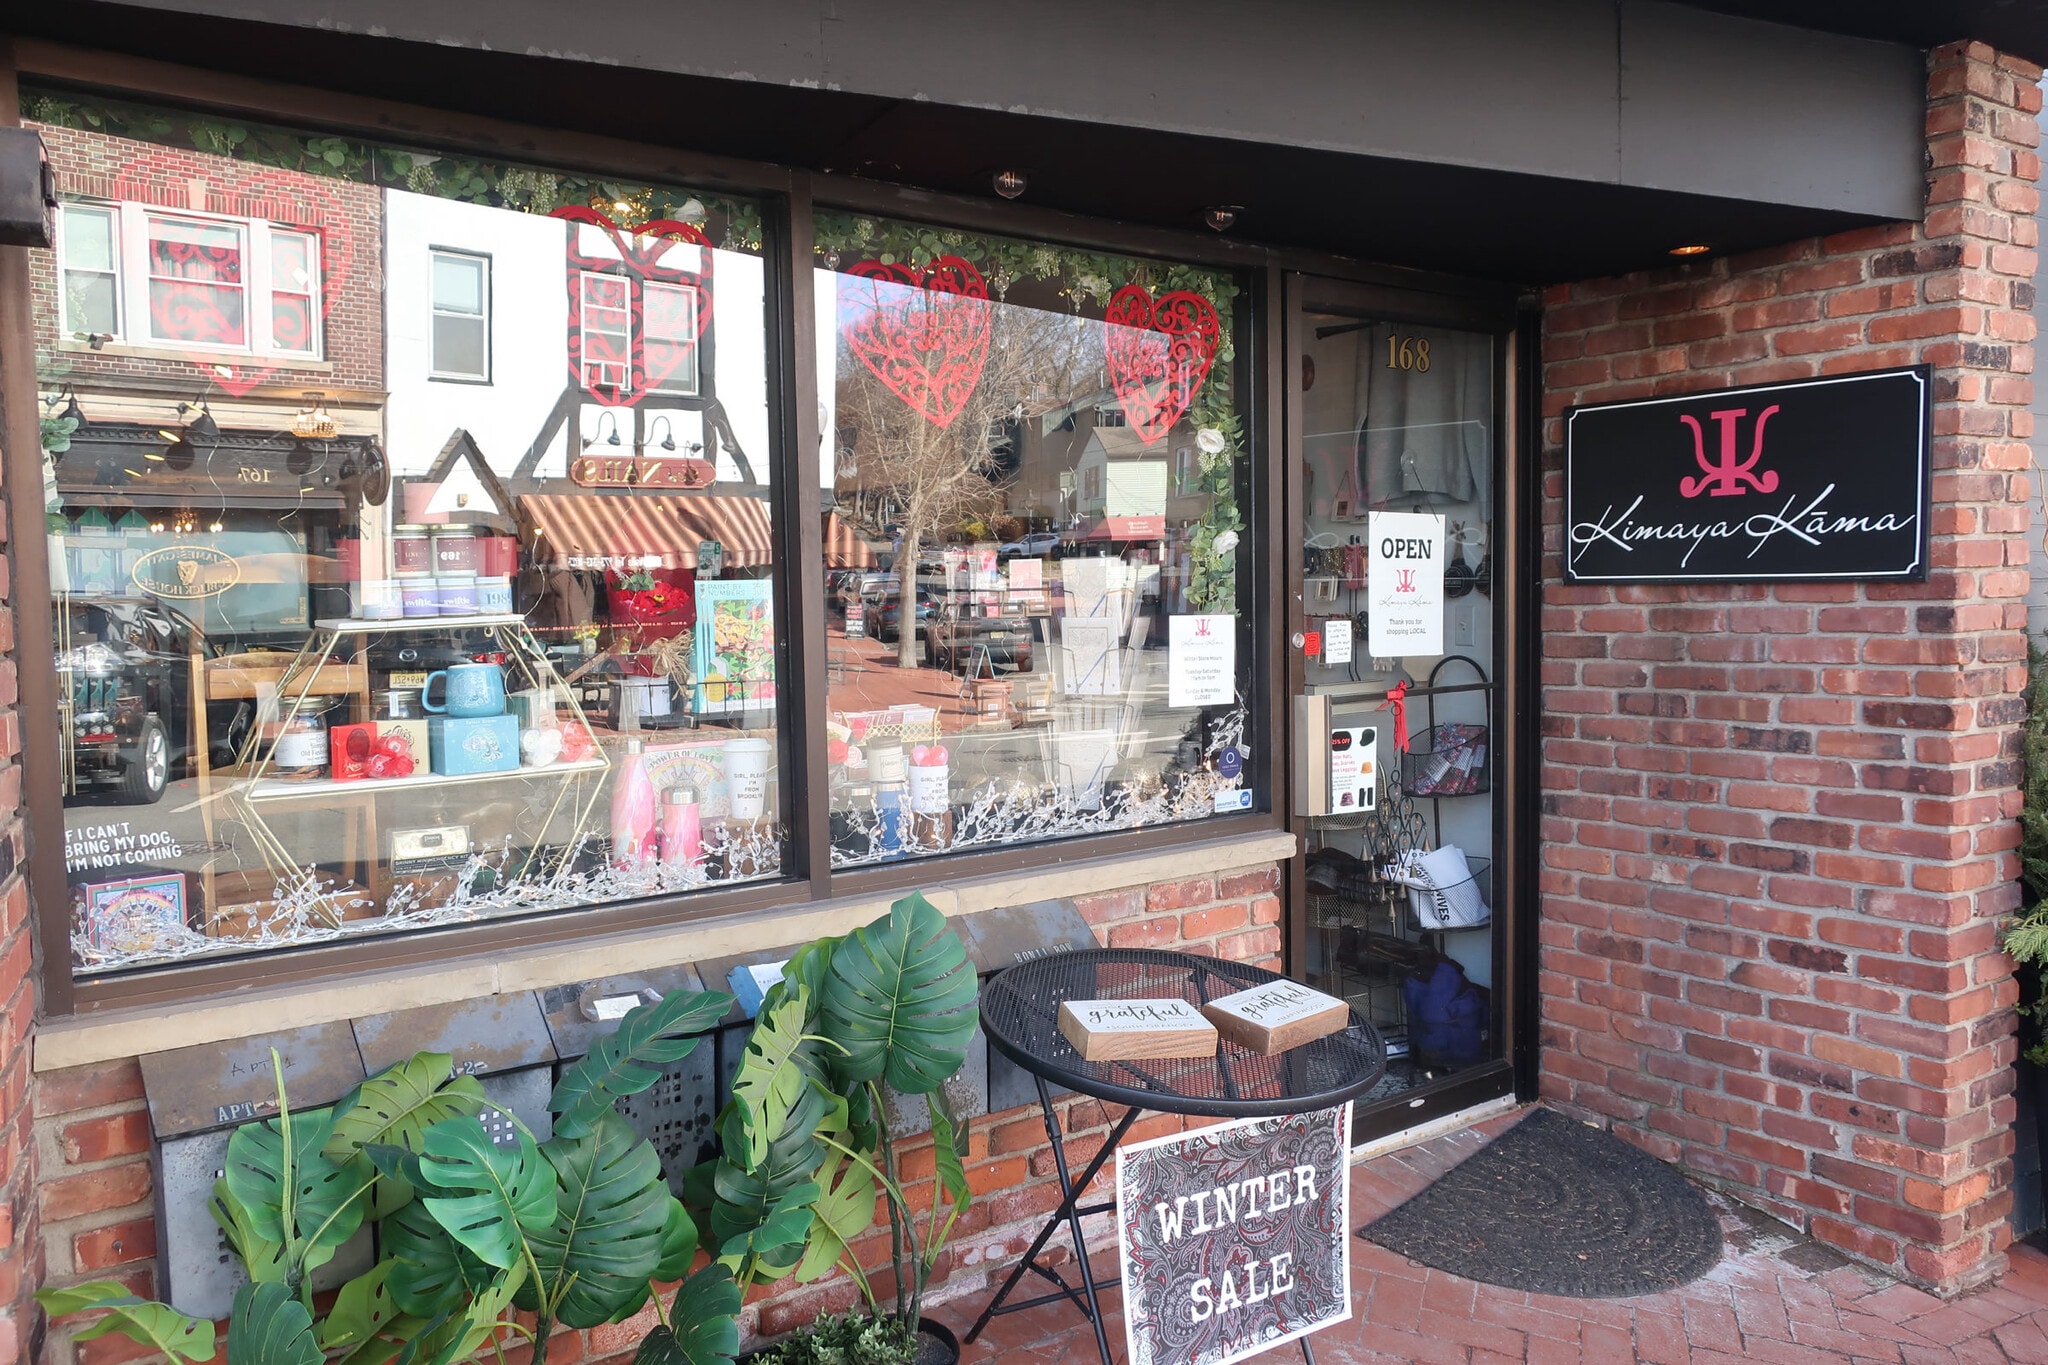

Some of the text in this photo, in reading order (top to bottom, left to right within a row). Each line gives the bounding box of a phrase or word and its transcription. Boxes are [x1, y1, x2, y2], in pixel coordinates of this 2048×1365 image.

[1386, 335, 1431, 372] 168
[1571, 495, 1746, 568] Kimaya
[1381, 538, 1432, 559] OPEN
[1386, 628, 1409, 636] shopping
[65, 831, 175, 858] BRING MY DOG,
[78, 828, 83, 840] I
[86, 822, 130, 839] CAN'T
[66, 845, 182, 874] I'M NOT COMING
[1089, 1003, 1189, 1024] grateful
[1241, 985, 1311, 1021] grateful
[218, 1102, 254, 1122] APT
[1155, 1164, 1319, 1243] WINTER
[1190, 1252, 1294, 1324] SALE
